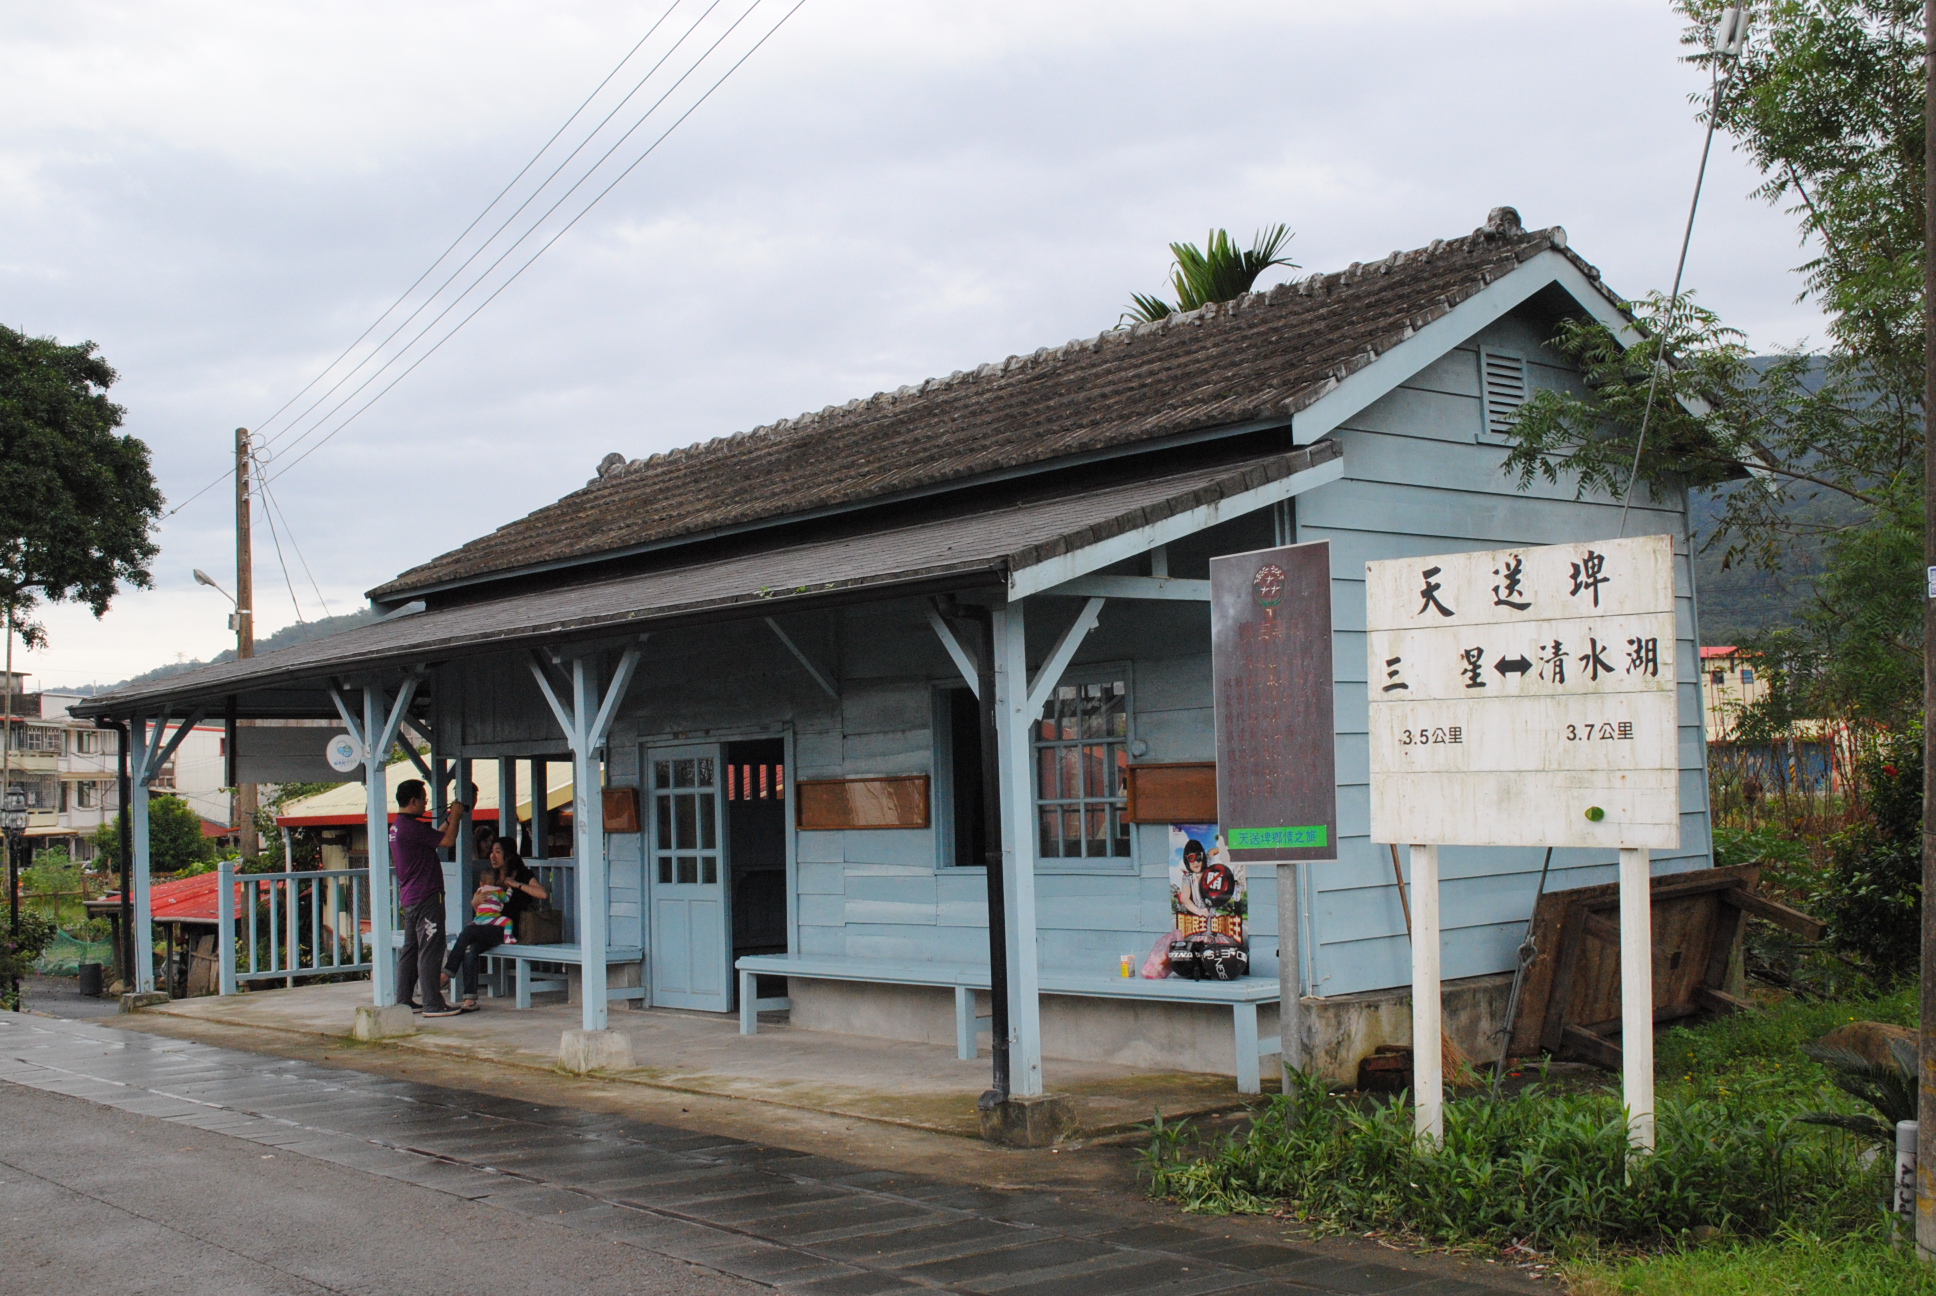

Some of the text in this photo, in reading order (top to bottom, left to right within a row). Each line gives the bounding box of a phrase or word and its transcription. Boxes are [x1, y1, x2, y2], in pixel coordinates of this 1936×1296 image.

[1418, 550, 1610, 617] 天送埤
[1382, 636, 1659, 692] 三星 清水湖
[1402, 721, 1634, 745] 3.5公里 3.7公里
